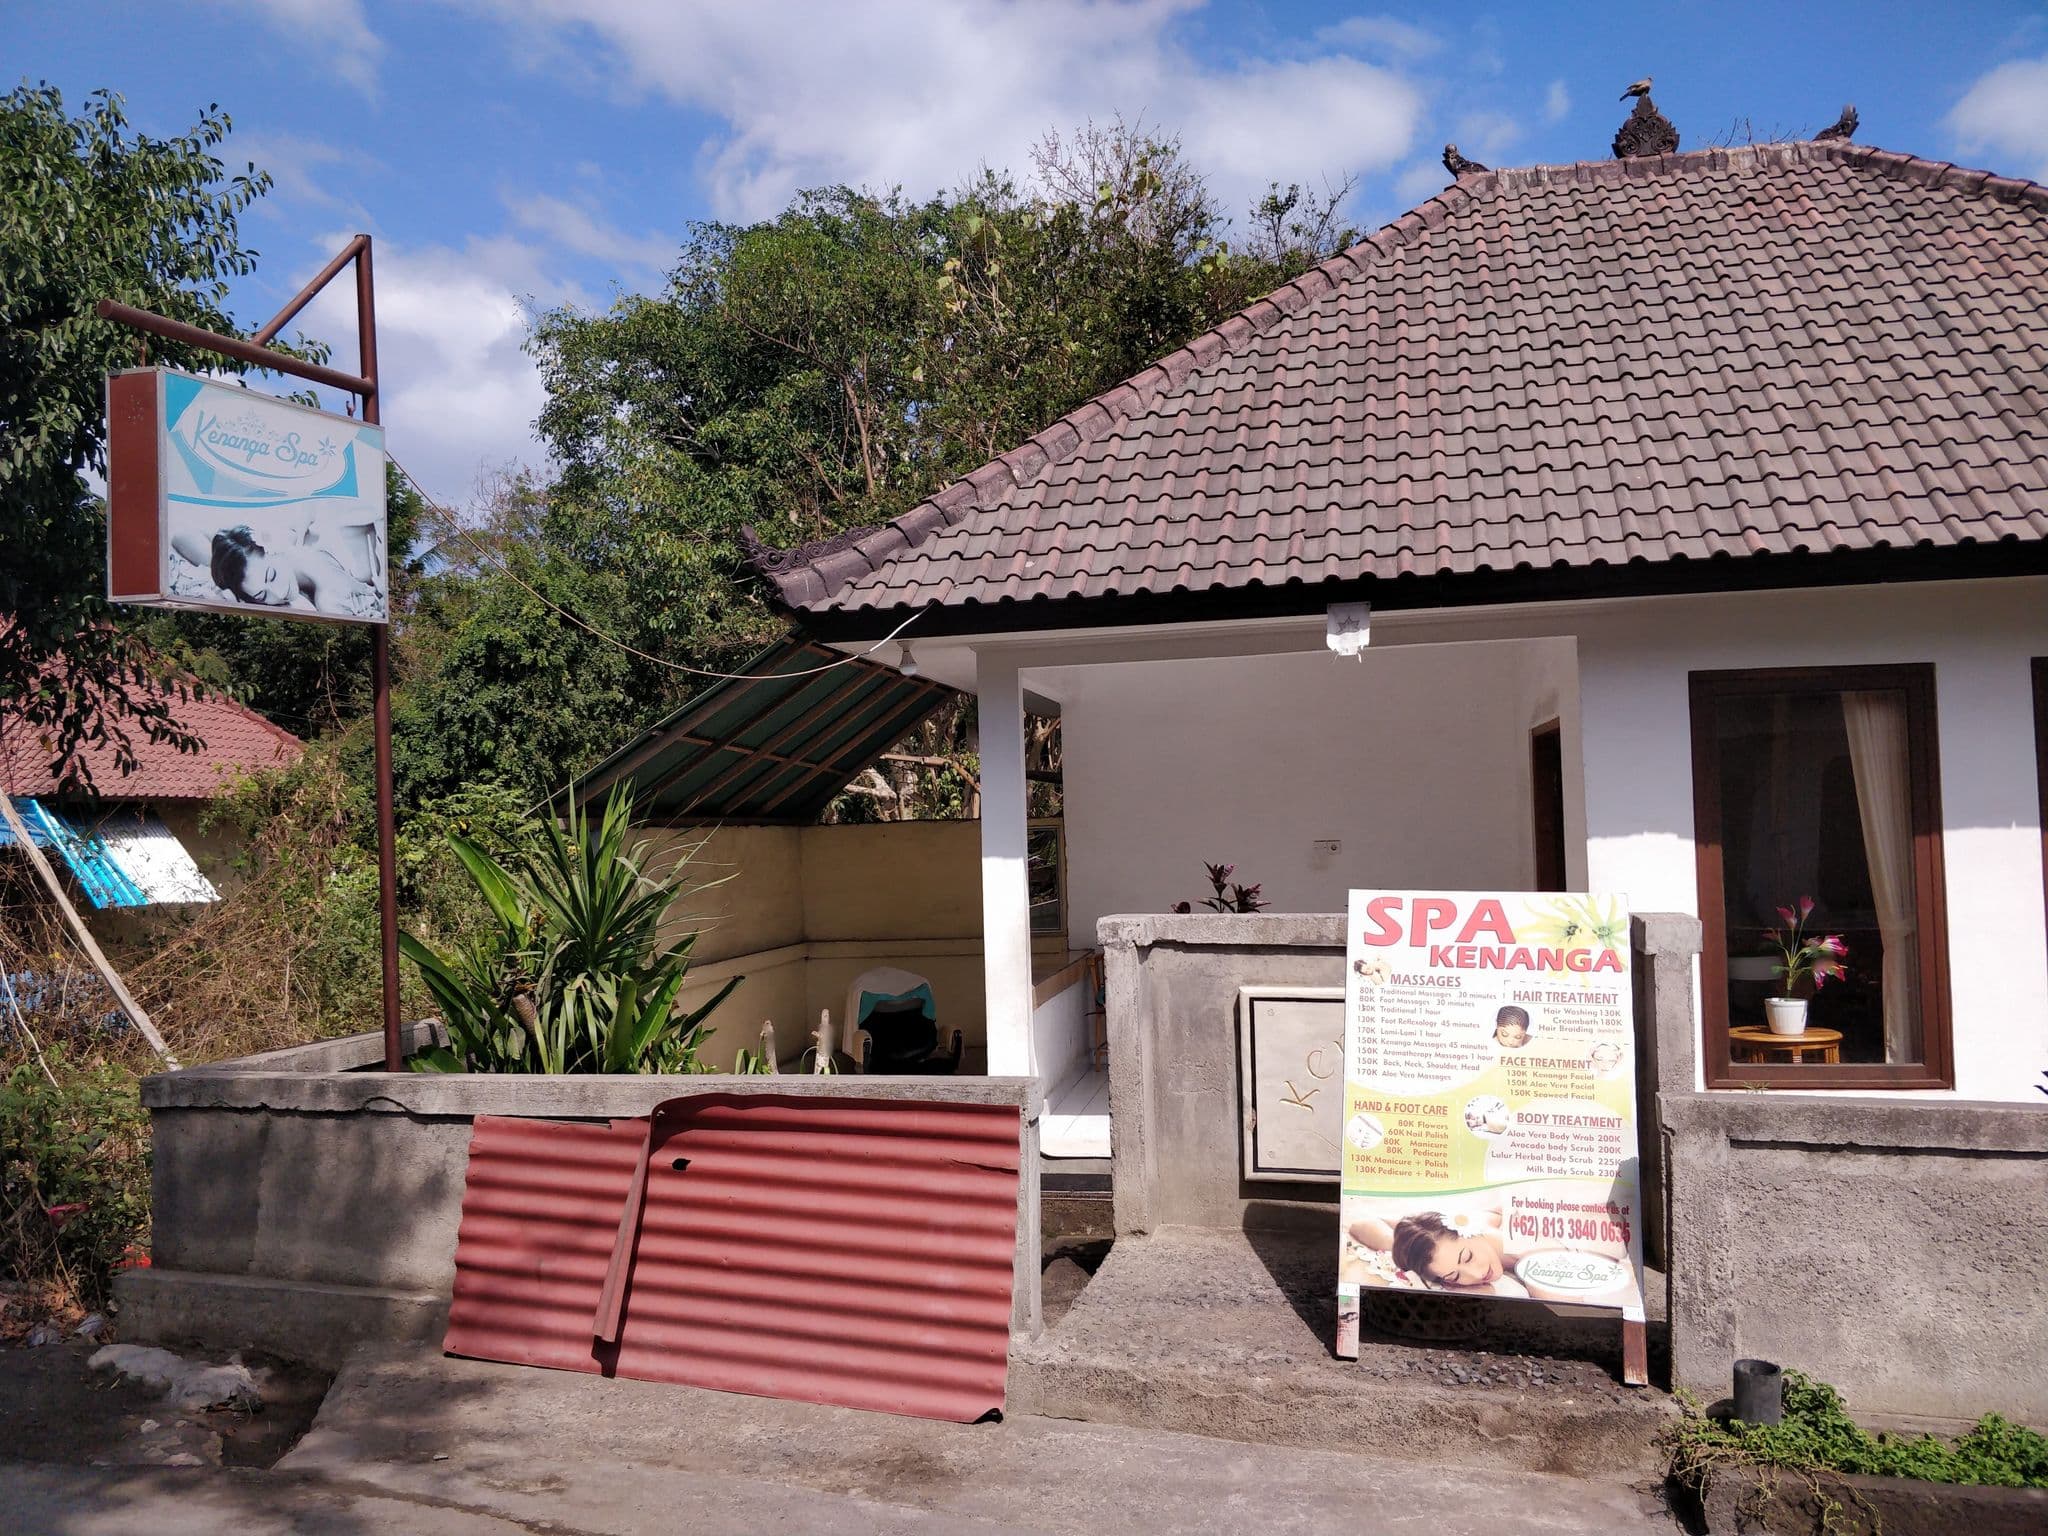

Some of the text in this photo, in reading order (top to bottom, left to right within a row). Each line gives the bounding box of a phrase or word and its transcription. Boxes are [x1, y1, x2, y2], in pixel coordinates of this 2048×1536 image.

[275, 432, 319, 468] Spa
[1363, 896, 1516, 947] SPA
[1430, 945, 1623, 973] KENANGA
[1390, 974, 1461, 987] MASSAGES
[1380, 988, 1416, 996] Traditional
[1513, 990, 1618, 1004] HAIR TREATMENT
[1397, 998, 1430, 1006] Massages
[1380, 1006, 1416, 1014] Traditional
[1564, 1008, 1598, 1018] Washing
[1452, 1021, 1480, 1029] minutes
[1539, 1024, 1558, 1032] Hair
[1560, 1025, 1594, 1034] Braiding
[1380, 1038, 1411, 1047] Kenanga
[1413, 1041, 1447, 1049] Massages
[1383, 1049, 1432, 1059] Aromatherapy
[1434, 1052, 1468, 1061] Massages
[1500, 1056, 1592, 1069] FACE TREATMENT
[1357, 1068, 1377, 1076] 170K
[1417, 1073, 1451, 1081] Massages
[1532, 1071, 1567, 1080] Kenanga
[1530, 1080, 1548, 1088] Aloe
[1534, 1091, 1568, 1099] Seaweed
[1354, 1100, 1448, 1115] HAND & FOOT CARE
[1418, 1121, 1448, 1130] Flowers
[1517, 1112, 1622, 1128] BODY TREATMENT
[1425, 1131, 1449, 1139] Polish
[1507, 1130, 1525, 1138] Aloe
[1528, 1131, 1546, 1139] Vera
[1550, 1132, 1569, 1140] Body
[1410, 1140, 1448, 1148] Manicure
[1510, 1141, 1622, 1154] Avocado body Scrub 200K
[1413, 1148, 1448, 1158] Pedicure
[1515, 1152, 1544, 1161] Herbal
[1546, 1154, 1566, 1163] Body
[1569, 1156, 1593, 1164] Scrub
[1599, 1158, 1622, 1166] 225K
[1351, 1154, 1372, 1163] 130K
[1374, 1157, 1412, 1166] Manicure
[1425, 1160, 1448, 1168] Polish
[1356, 1166, 1377, 1174] 130K
[1378, 1167, 1413, 1176] Pedicure
[1425, 1170, 1448, 1178] Polish
[1526, 1166, 1622, 1178] Milk Body Scrub 230K
[1512, 1196, 1629, 1215] For booking please contact us at
[1509, 1214, 1630, 1243] (+62) 813 3840 0635
[1577, 1264, 1608, 1283] Spa
